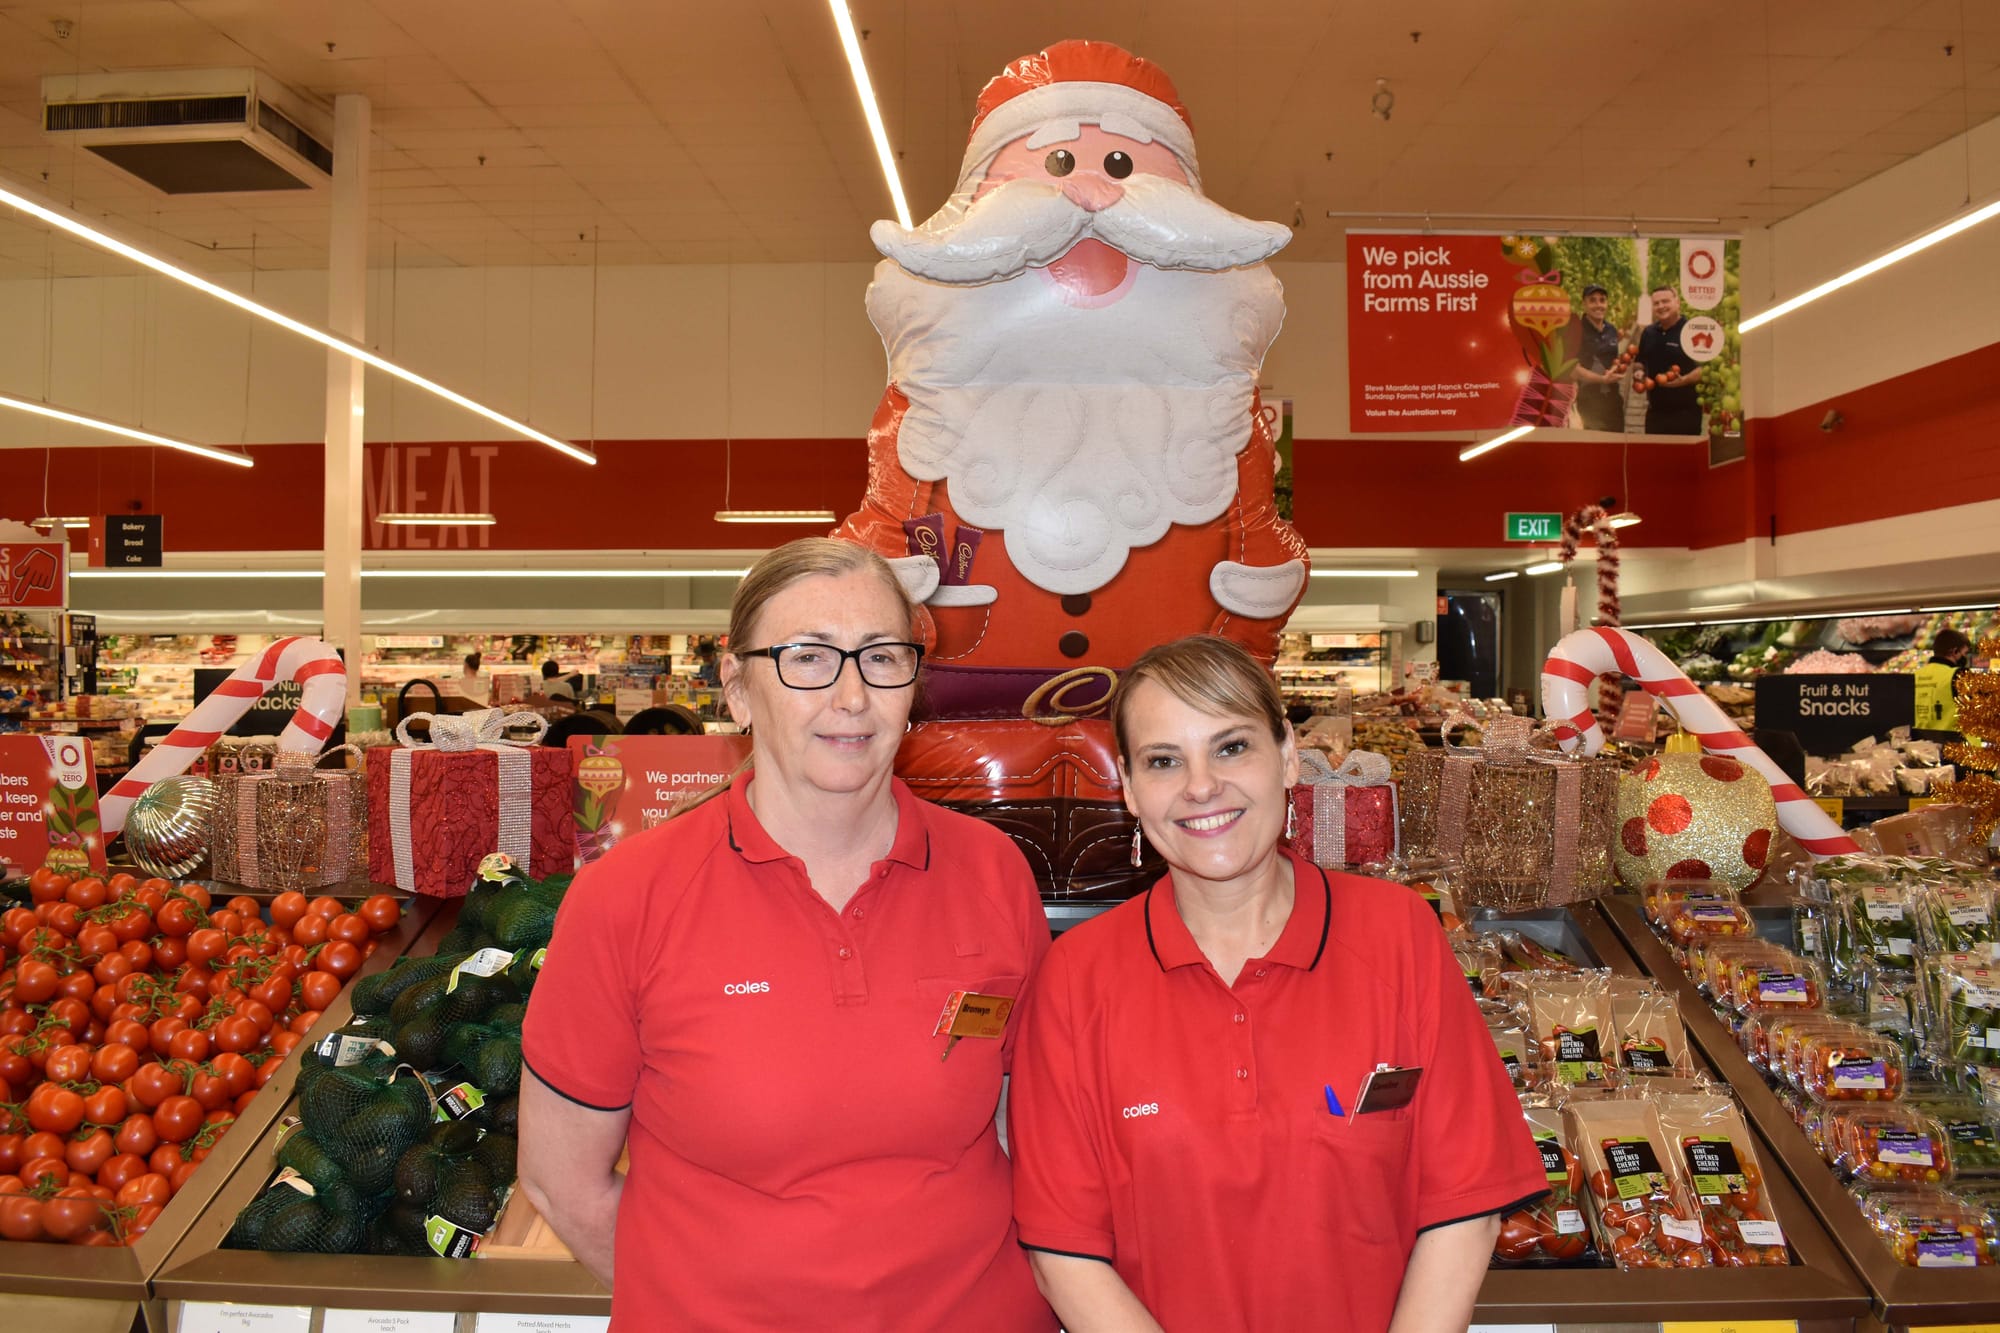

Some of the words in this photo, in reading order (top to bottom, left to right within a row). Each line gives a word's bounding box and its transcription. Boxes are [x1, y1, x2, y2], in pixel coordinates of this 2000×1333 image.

[1363, 246, 1398, 266] We
[1403, 246, 1451, 270] pick
[1363, 269, 1413, 289] from
[1418, 269, 1489, 289] Aussie
[1688, 285, 1716, 294] BETTER
[1364, 292, 1430, 312] Farms
[1436, 292, 1478, 312] First
[1364, 384, 1384, 392] Steve
[1421, 383, 1437, 391] and
[1437, 383, 1462, 391] Franck
[1364, 392, 1395, 401] Sundrop
[1420, 391, 1436, 399] Port
[1365, 409, 1386, 417] Value
[1387, 408, 1400, 417] the
[1401, 408, 1440, 417] Australian
[1440, 408, 1457, 417] way
[362, 446, 499, 549] MEAT
[122, 523, 145, 532] Bakery
[1518, 518, 1551, 536] EXIT
[93, 537, 99, 548] 1
[123, 539, 144, 547] Bread
[125, 555, 142, 563] Cake
[957, 542, 973, 581] Cadbury
[1800, 684, 1828, 697] Fruit
[1831, 684, 1842, 697] &
[1845, 684, 1870, 697] Nut
[253, 694, 301, 711] acks
[1799, 698, 1871, 716] Snacks
[646, 771, 668, 784] We
[671, 771, 725, 786] partner
[5, 792, 38, 806] keep
[16, 810, 43, 822] and
[723, 980, 771, 996] coles
[962, 1003, 991, 1017] Bronwyn
[1122, 1101, 1160, 1120] coles
[1611, 1148, 1626, 1156] VINE
[1613, 1153, 1640, 1163] RIPENED
[1616, 1160, 1640, 1169] CHERRY
[229, 1310, 248, 1319] perfect
[248, 1311, 274, 1319] Avocados
[517, 1320, 536, 1328] Potted
[536, 1320, 554, 1328] Mixed
[554, 1321, 572, 1329] Herbs
